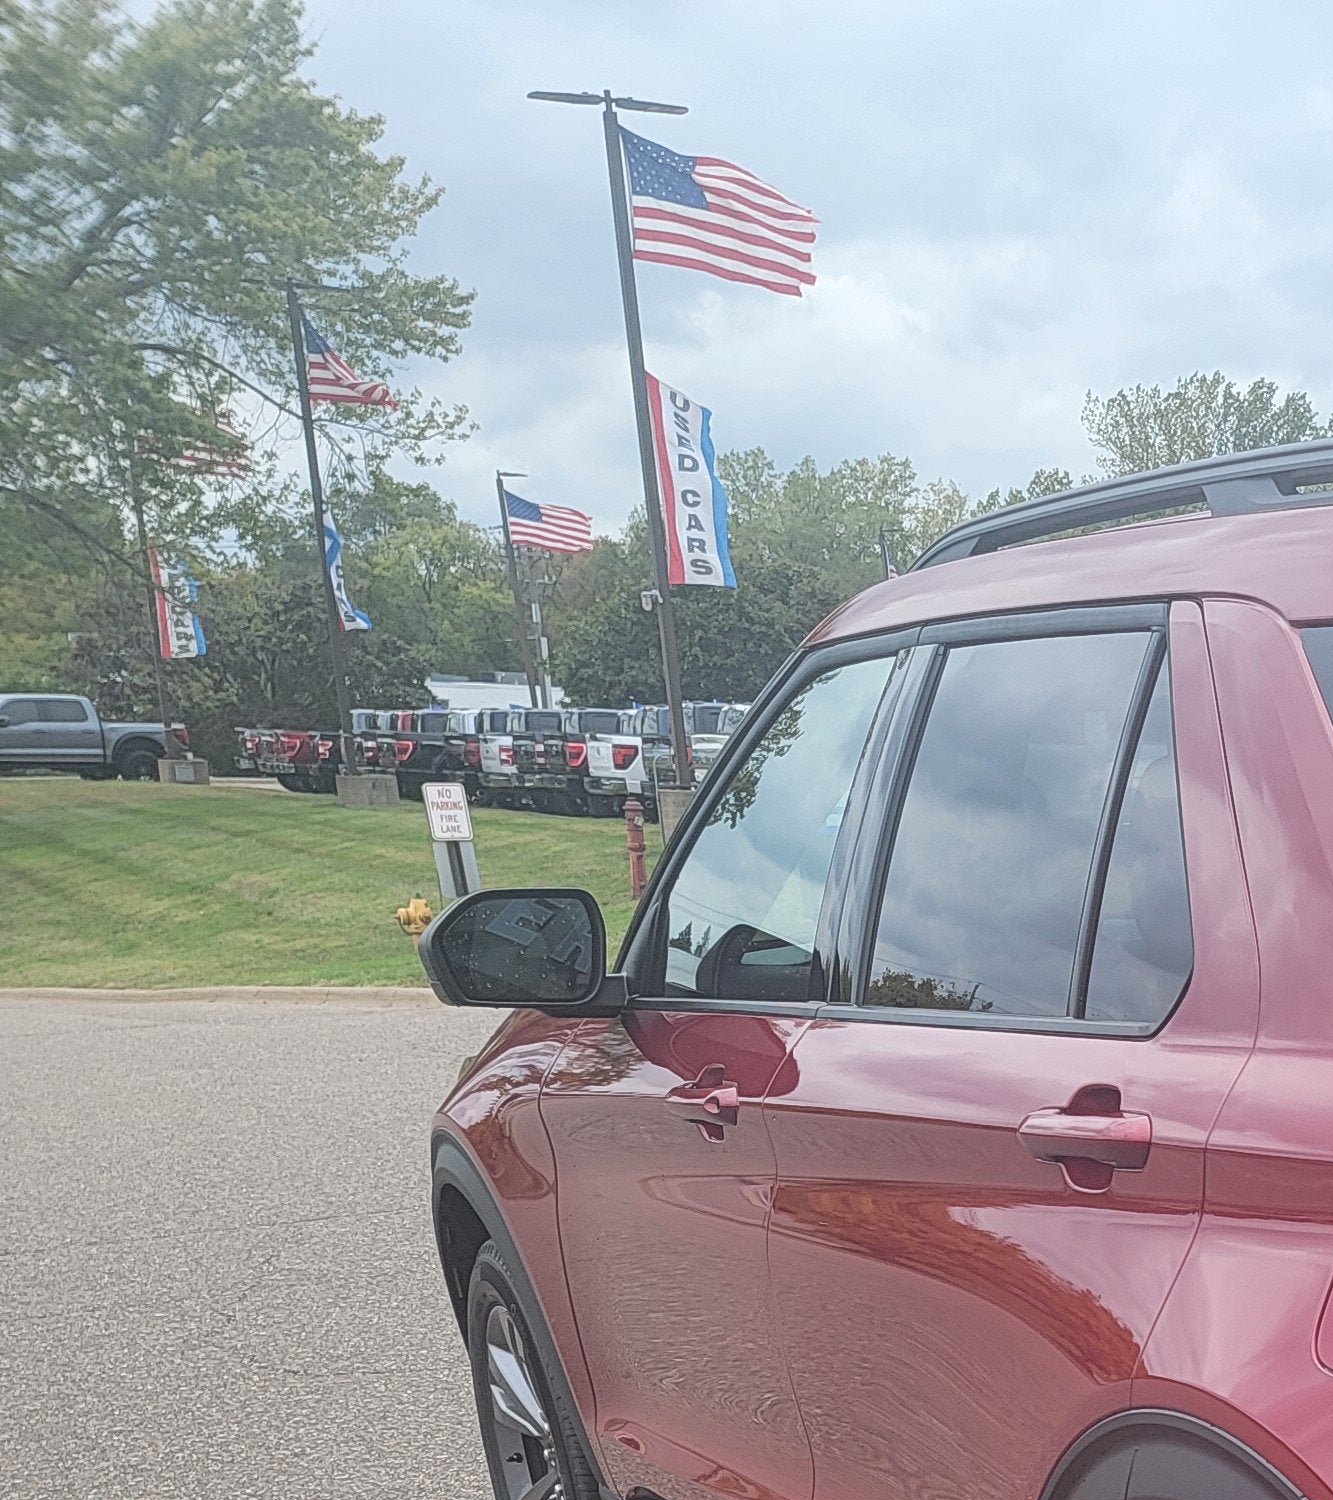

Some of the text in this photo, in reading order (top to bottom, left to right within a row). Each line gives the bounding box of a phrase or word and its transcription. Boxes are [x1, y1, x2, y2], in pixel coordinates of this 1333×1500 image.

[669, 391, 713, 576] USED CARS
[437, 788, 452, 799] NO
[431, 801, 464, 811] PARKING
[440, 814, 458, 824] FIRE
[440, 824, 463, 834] LANE
